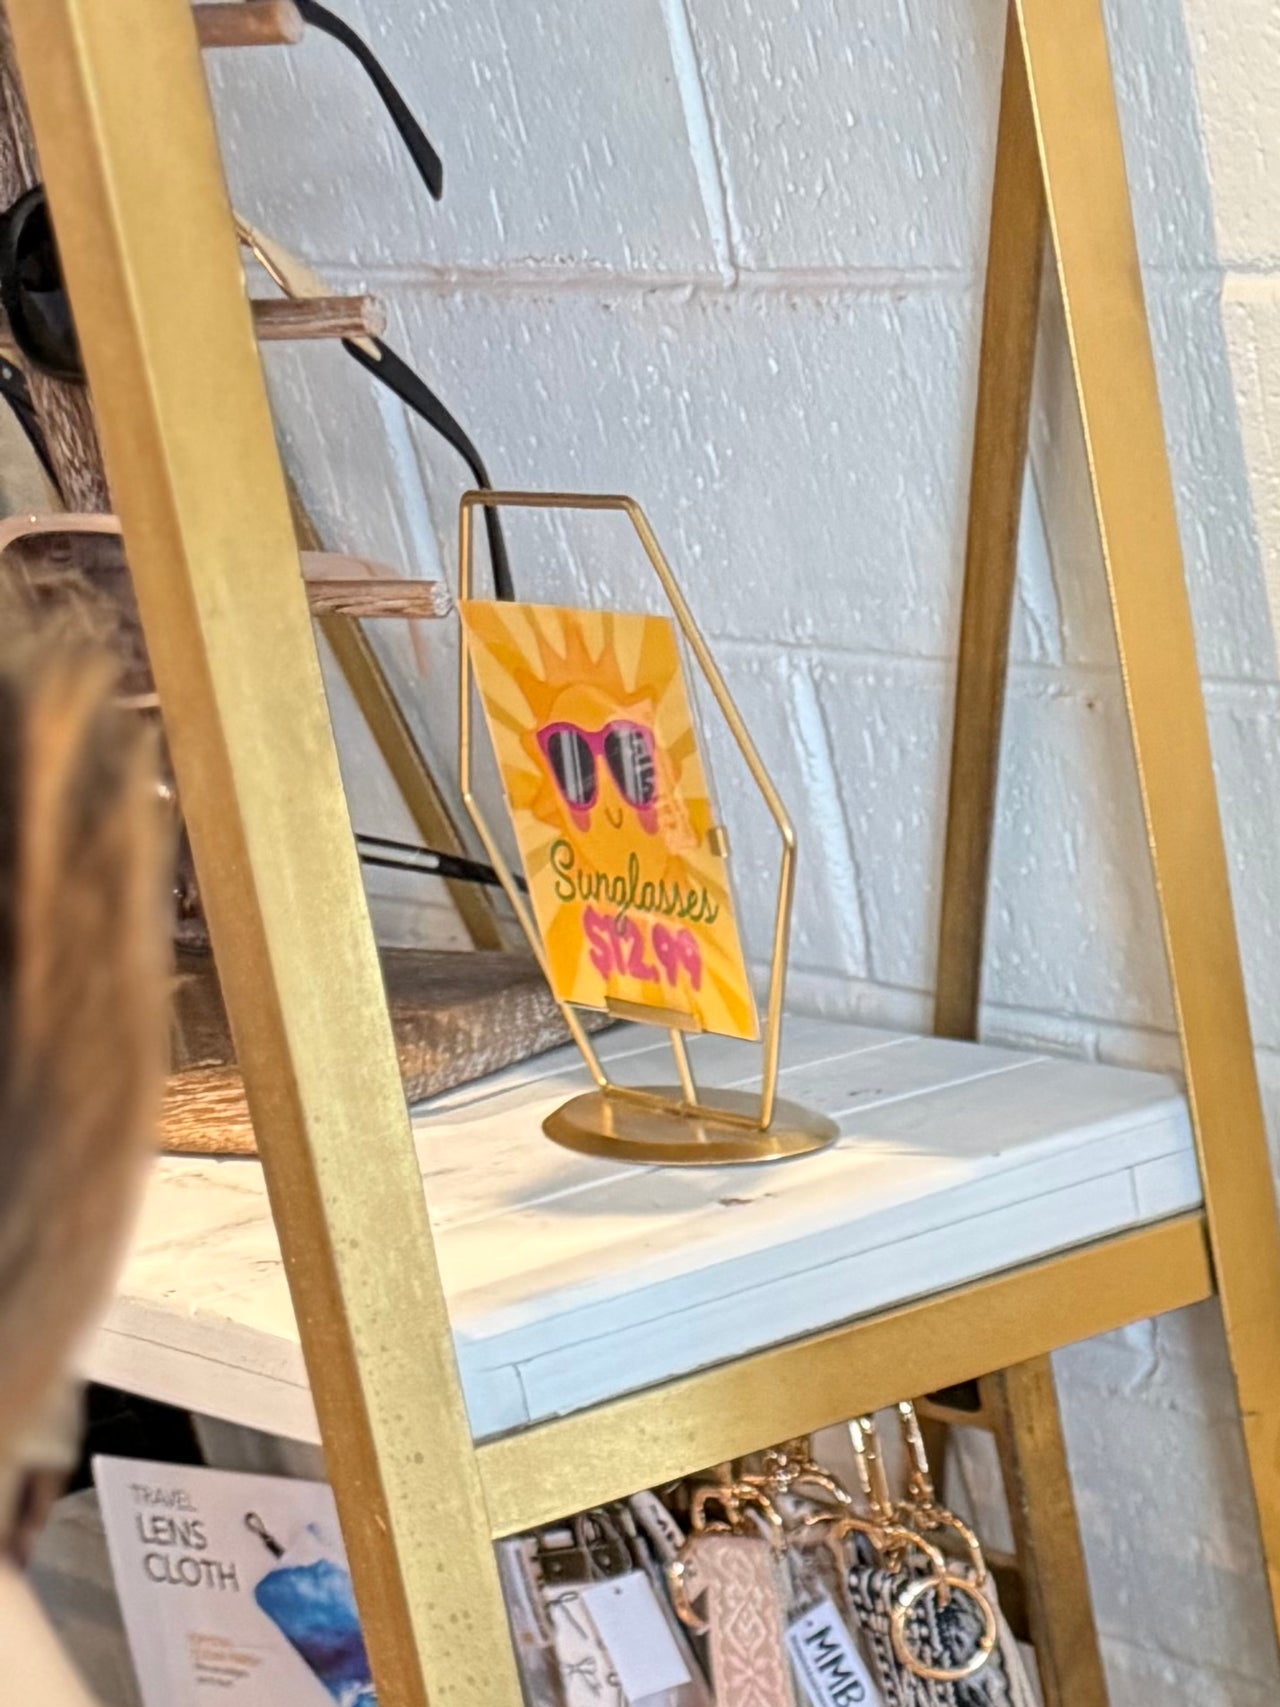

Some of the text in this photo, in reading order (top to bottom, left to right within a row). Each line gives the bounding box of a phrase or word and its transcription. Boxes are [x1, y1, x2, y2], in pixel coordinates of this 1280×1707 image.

[550, 839, 719, 936] Sunglasses
[582, 904, 703, 992] $12.99
[129, 1483, 198, 1513] TRAVEL
[135, 1514, 208, 1549] LENS
[143, 1552, 241, 1593] CLOTH
